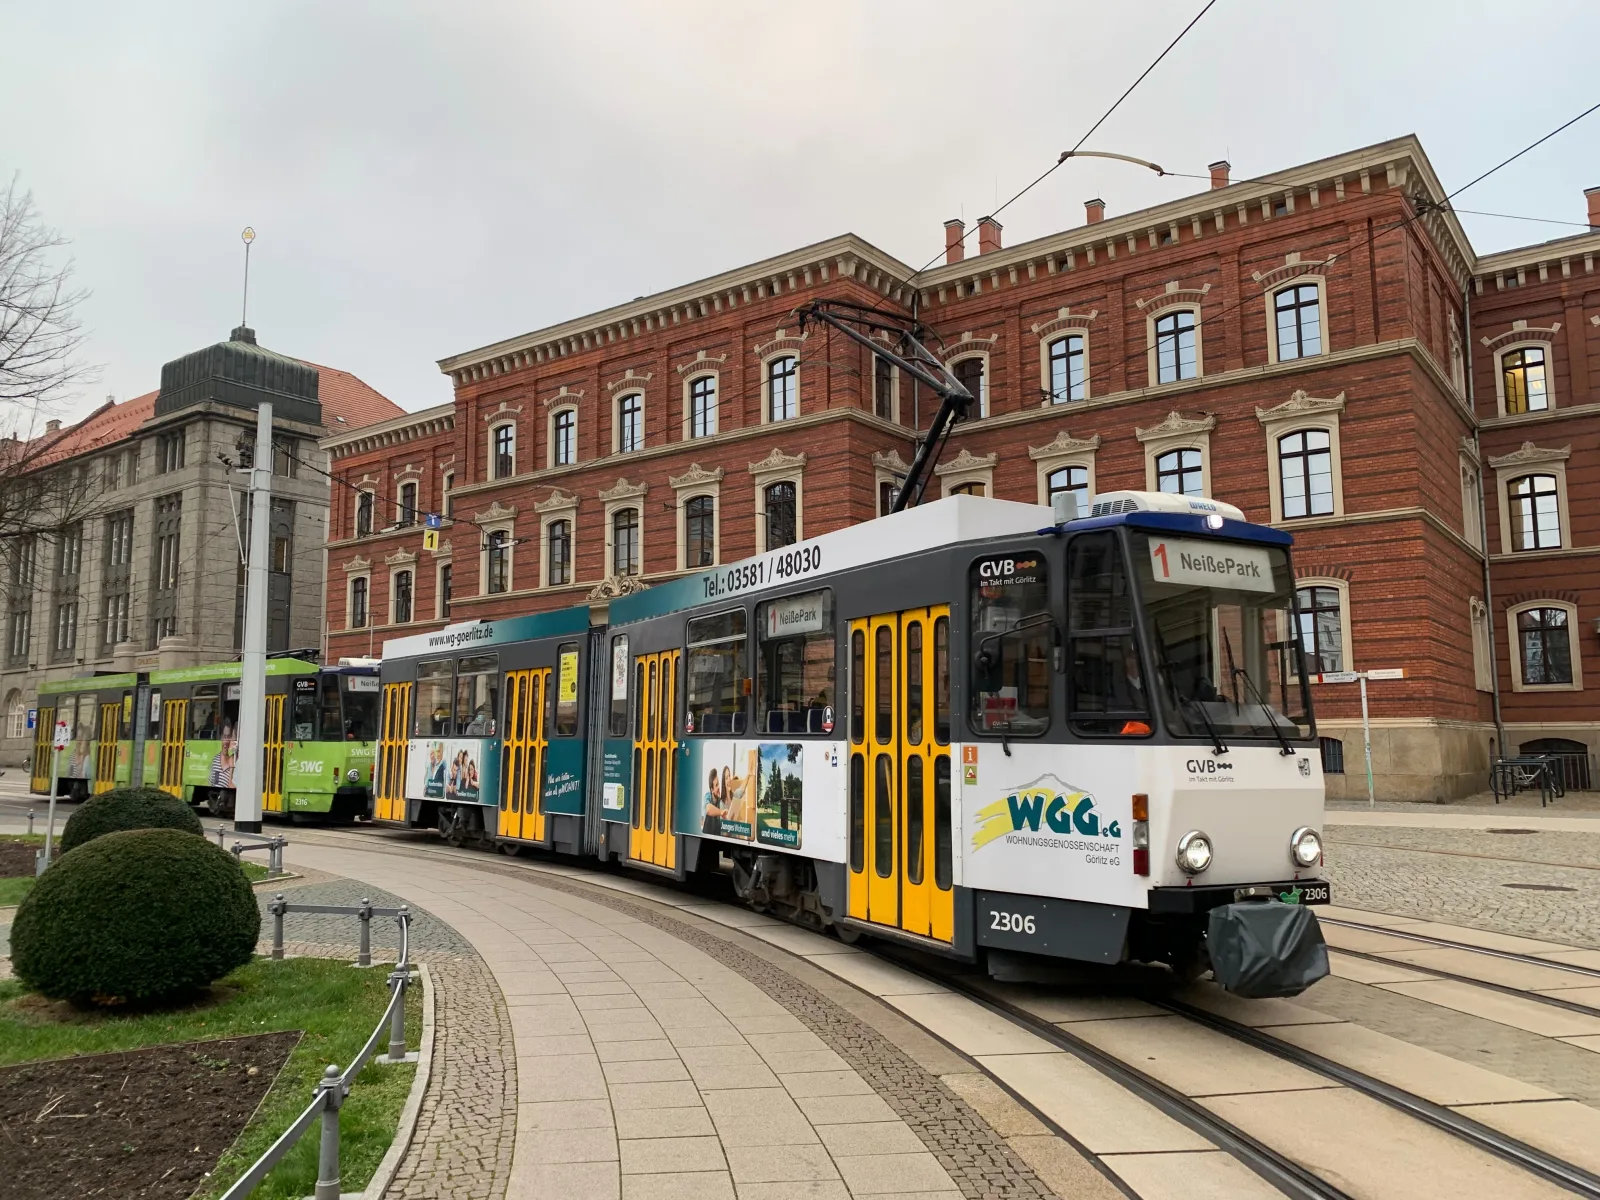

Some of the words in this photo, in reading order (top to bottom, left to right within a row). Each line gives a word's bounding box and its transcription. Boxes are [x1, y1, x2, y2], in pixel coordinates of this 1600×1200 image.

[427, 533, 434, 548] 1
[1153, 543, 1170, 578] 1
[1180, 552, 1260, 578] NeißePark
[703, 573, 725, 598] Tel.:
[727, 561, 764, 592] 03581
[768, 557, 774, 583] /
[776, 545, 821, 579] 48030
[980, 559, 1015, 577] GVB
[1015, 576, 1036, 584] Görlitz
[770, 608, 777, 634] 1
[779, 607, 817, 626] NeißePark
[428, 624, 494, 647] www.wg-goerlitz.de
[350, 677, 356, 690] 1
[351, 748, 370, 756] SWG
[300, 761, 324, 773] SWG
[1186, 759, 1216, 773] GVB
[295, 798, 308, 806] 2316
[1007, 793, 1101, 836] WGG
[1102, 820, 1121, 838] eG
[720, 821, 735, 833] Junges
[735, 823, 751, 835] Wohnen
[761, 829, 771, 838] und
[771, 828, 784, 840] vieles
[784, 831, 796, 842] mehr
[1006, 835, 1120, 854] WOHNUNGSGENOSSENSCHAFT
[1085, 854, 1108, 866] Görlitz
[1109, 857, 1121, 866] eG
[1304, 887, 1328, 900] 2306
[990, 910, 1036, 935] 2306
